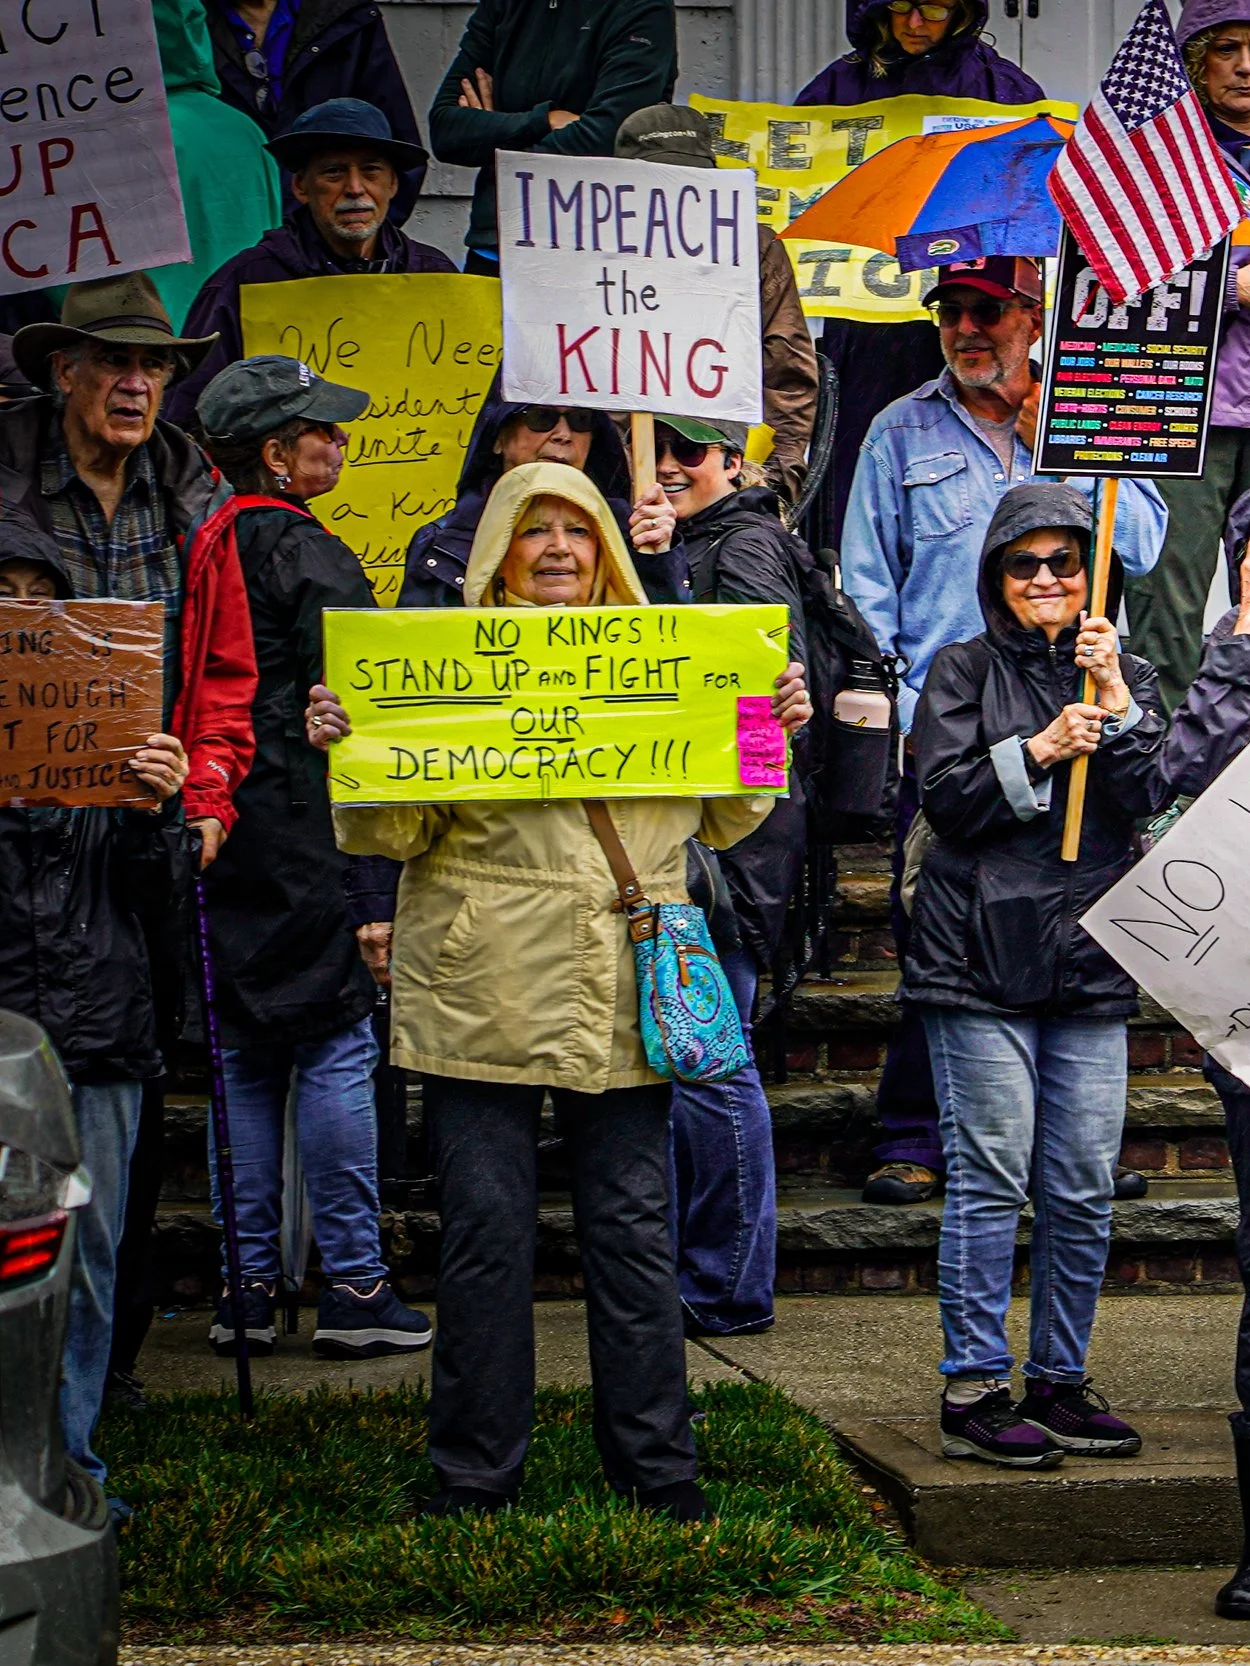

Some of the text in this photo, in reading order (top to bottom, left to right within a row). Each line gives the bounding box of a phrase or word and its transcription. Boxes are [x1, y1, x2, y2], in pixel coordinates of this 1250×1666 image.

[515, 171, 740, 266] IMPEACH
[596, 266, 660, 315] the
[280, 317, 360, 375] We
[556, 323, 729, 399] KING
[356, 388, 481, 421] sident
[332, 488, 456, 521] a Kin
[475, 618, 520, 649] NO
[350, 655, 741, 692] STAND UP AND FIGHT FOR
[47, 721, 98, 754] FOR
[511, 706, 584, 735] OUR
[28, 763, 135, 790] JUSTICE
[1109, 860, 1225, 961] NO
